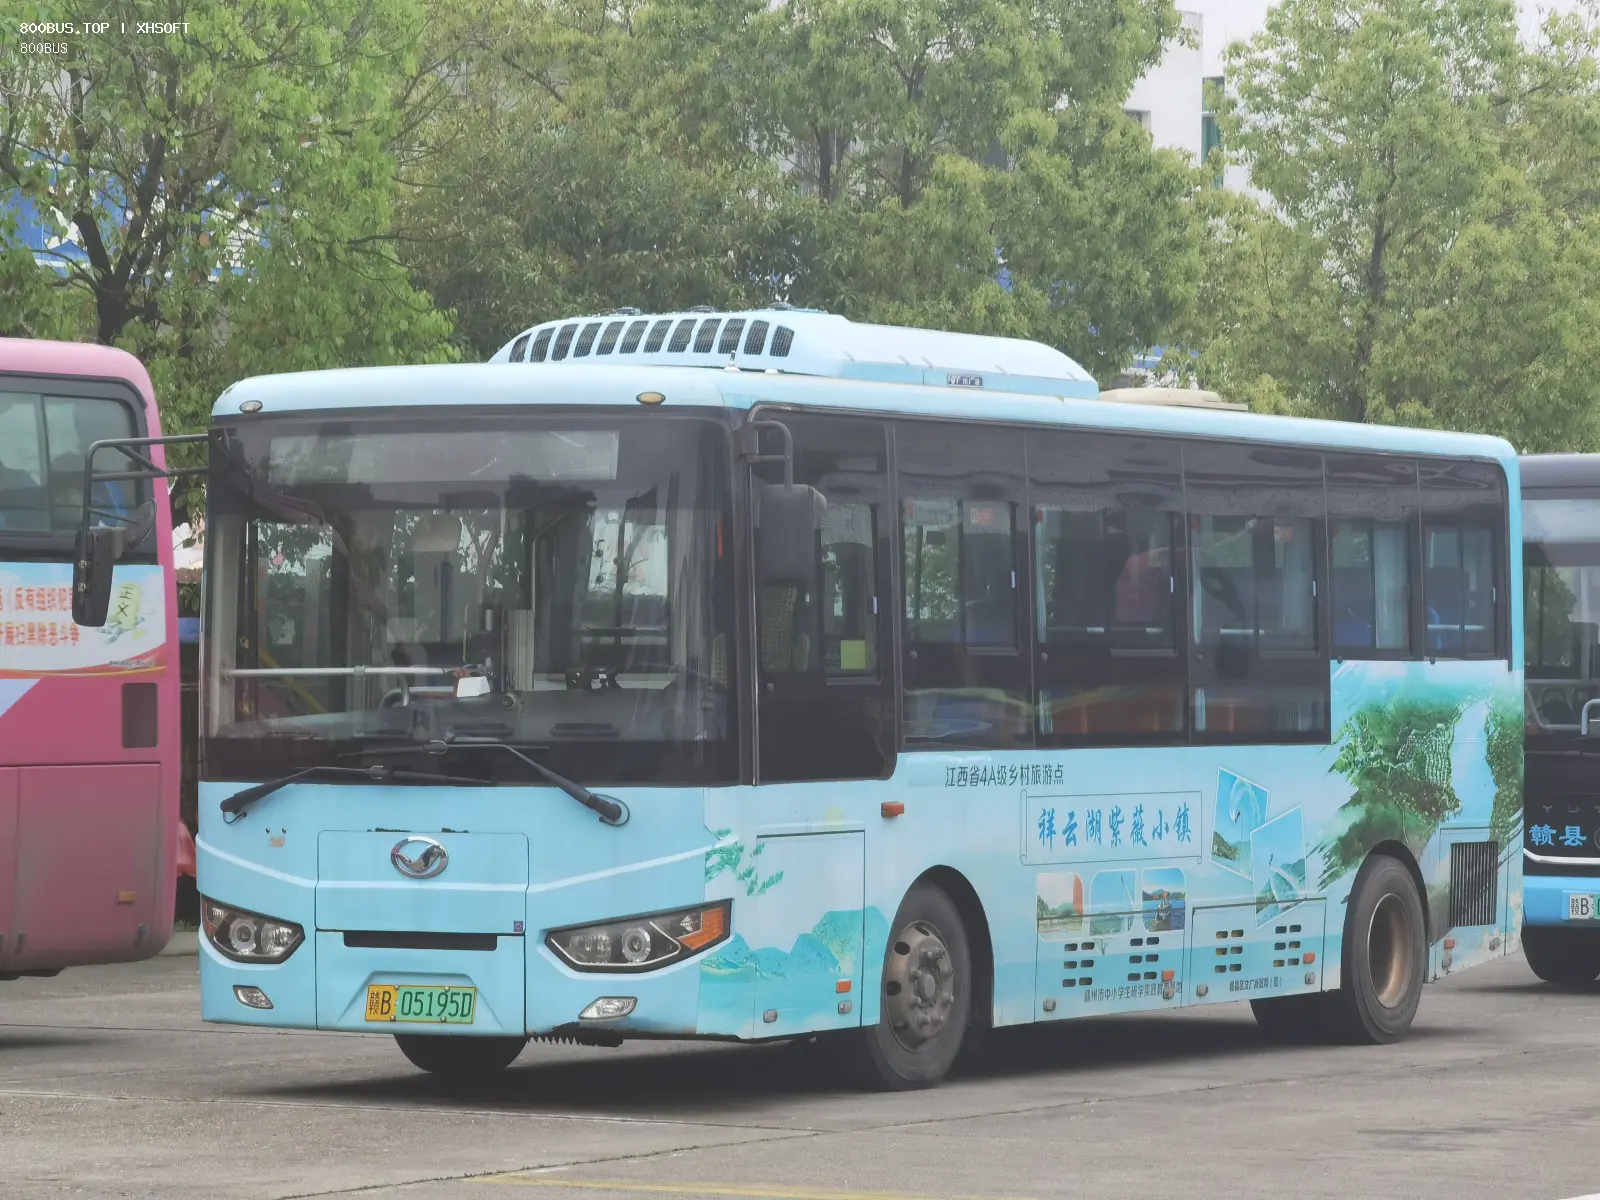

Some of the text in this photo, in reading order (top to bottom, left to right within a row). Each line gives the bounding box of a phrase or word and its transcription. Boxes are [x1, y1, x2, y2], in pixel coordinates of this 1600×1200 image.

[945, 763, 1064, 788] 江西省4A级乡村旅游点
[1037, 802, 1192, 850] 祥云湖紫薇小镇
[1529, 823, 1587, 847] 赣县
[1571, 897, 1600, 916] 赣B
